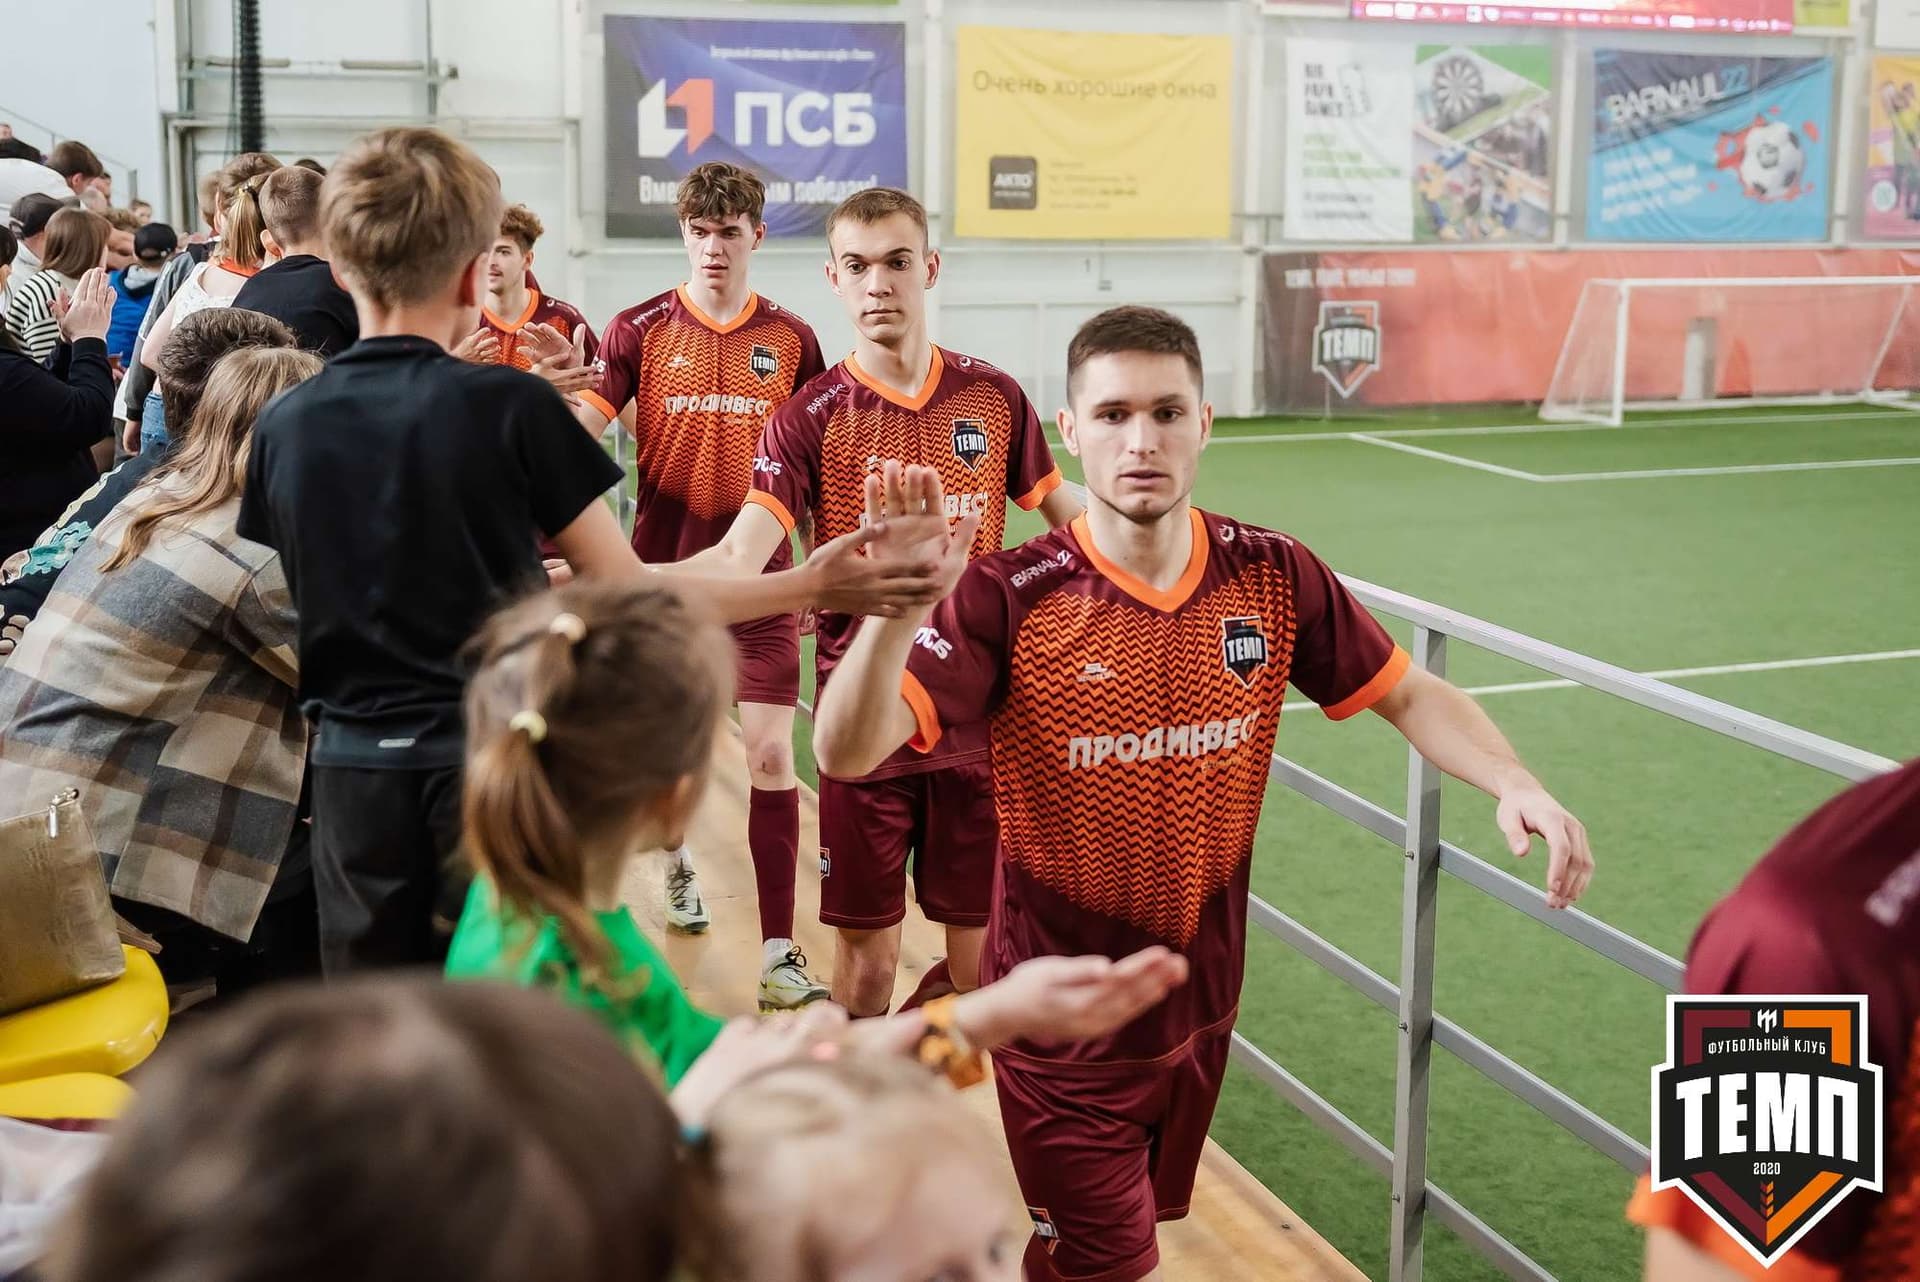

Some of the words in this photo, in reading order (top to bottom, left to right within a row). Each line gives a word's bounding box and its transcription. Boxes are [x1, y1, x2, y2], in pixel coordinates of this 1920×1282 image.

[973, 69, 1046, 95] Очень
[1053, 79, 1157, 101] хорошие
[1162, 81, 1217, 99] окна
[1606, 72, 1726, 124] BARNAUL
[734, 91, 876, 147] ПСБ
[1321, 328, 1376, 363] ТЕМП
[753, 356, 775, 372] ТЕМП
[956, 433, 985, 452] ТЕМП
[1226, 636, 1263, 663] ТЕМП
